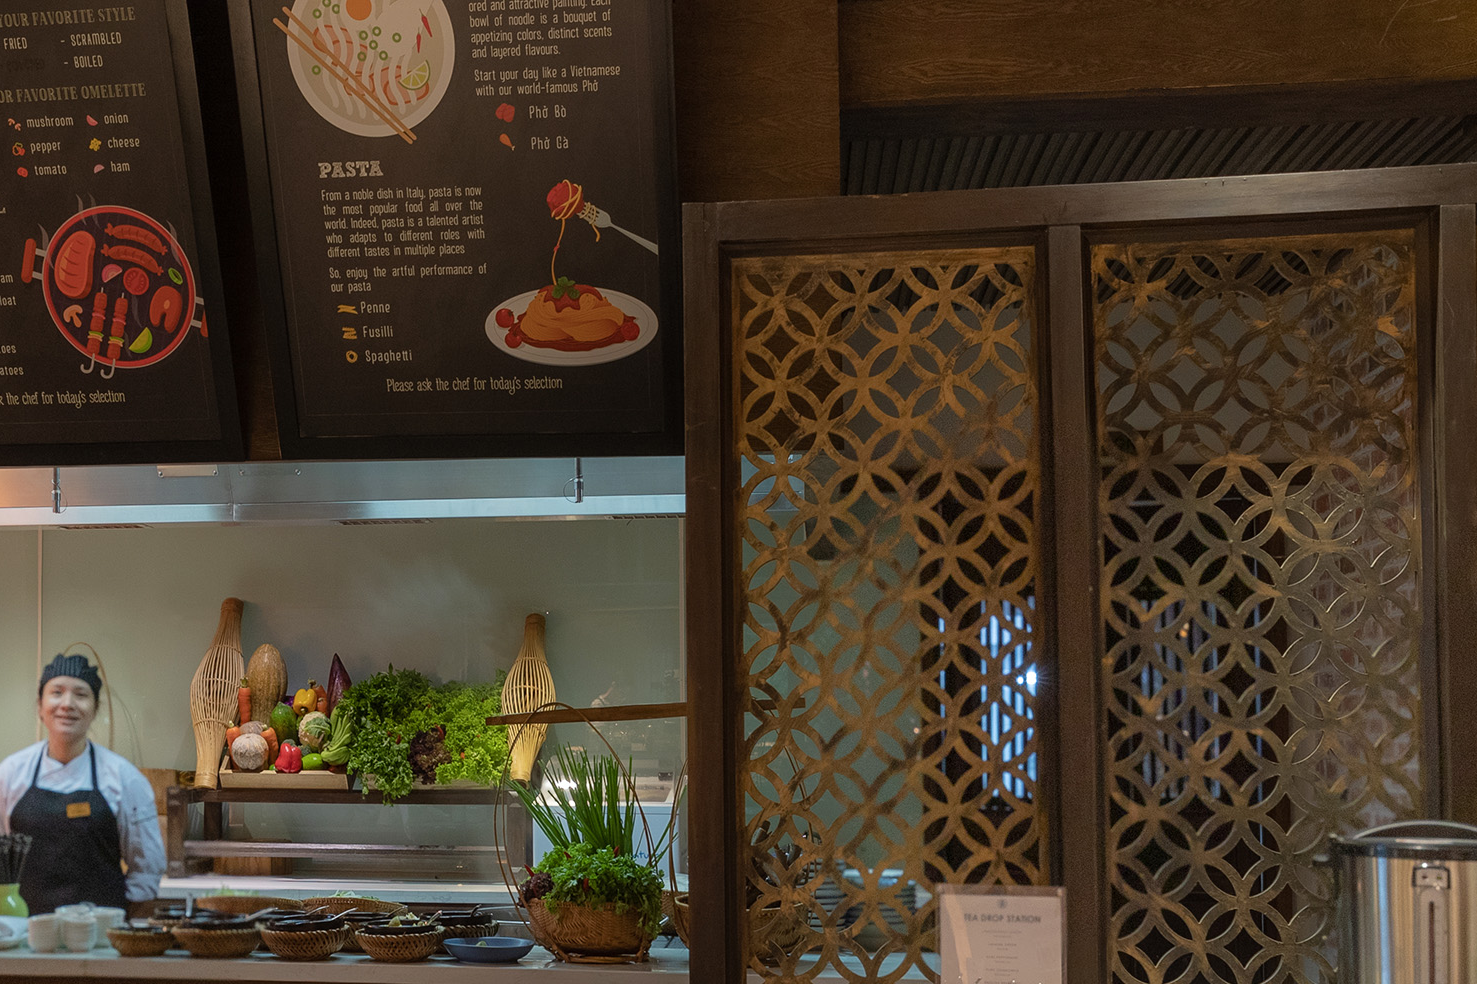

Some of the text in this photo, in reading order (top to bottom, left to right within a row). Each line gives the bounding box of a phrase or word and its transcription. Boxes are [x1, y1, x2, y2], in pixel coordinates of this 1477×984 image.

[468, 0, 487, 12] ored
[490, 0, 505, 11] and
[509, 0, 549, 10] attractive
[32, 9, 95, 26] FAVORITE
[98, 6, 136, 22] STYLE
[469, 9, 611, 28] bowl of noodle is a bouquet of
[70, 32, 122, 46] SCRAMBLED
[471, 30, 513, 44] appetizing
[548, 27, 579, 39] distinct
[584, 26, 612, 38] scents
[3, 37, 27, 49] FRIED
[472, 44, 560, 59] and layered flavours.
[74, 55, 103, 68] BOILED
[474, 65, 620, 82] Start your day like a Vietnamese
[16, 86, 78, 102] FAVORITE
[81, 83, 146, 99] OMELETTE
[475, 79, 598, 96] with our world-famous Phở
[104, 113, 129, 124] onion
[529, 104, 566, 119] Phở Bò
[26, 116, 74, 127] mushroom
[30, 142, 60, 154] pepper
[108, 137, 140, 148] cheese
[531, 136, 569, 150] Phở Gà
[34, 165, 67, 176] tomato
[110, 161, 130, 172] ham
[318, 160, 383, 178] PASTA
[321, 190, 342, 201] From
[345, 192, 350, 200] a
[353, 188, 374, 200] noble
[377, 188, 393, 199] dish
[396, 188, 404, 198] in
[428, 187, 452, 200] pasta
[454, 186, 462, 196] is
[465, 187, 482, 196] now
[323, 199, 483, 217] the most popular food all over the
[381, 217, 404, 230] pasta
[407, 216, 415, 227] is
[418, 218, 423, 227] a
[426, 214, 459, 226] talented
[462, 214, 484, 225] artist
[326, 228, 485, 245] who adapts to different roles with
[327, 243, 465, 258] different tastes in multiple places
[346, 267, 368, 280] enjoy
[373, 266, 386, 277] the
[392, 265, 415, 277] artful
[420, 264, 473, 278] performance
[478, 263, 486, 274] of
[331, 282, 371, 294] our pasta
[360, 301, 390, 313] Penne
[362, 325, 393, 338] Fusilli
[365, 350, 412, 364] Spaghetti
[386, 378, 414, 392] Please
[417, 378, 433, 391] ask
[435, 377, 449, 391] the
[452, 377, 470, 391] chef
[473, 377, 487, 390] for
[524, 376, 562, 389] selection
[6, 392, 20, 405] the
[22, 391, 39, 405] chef
[41, 391, 54, 404] for
[89, 390, 125, 403] selection
[964, 913, 1041, 923] TEA DROP STATION
